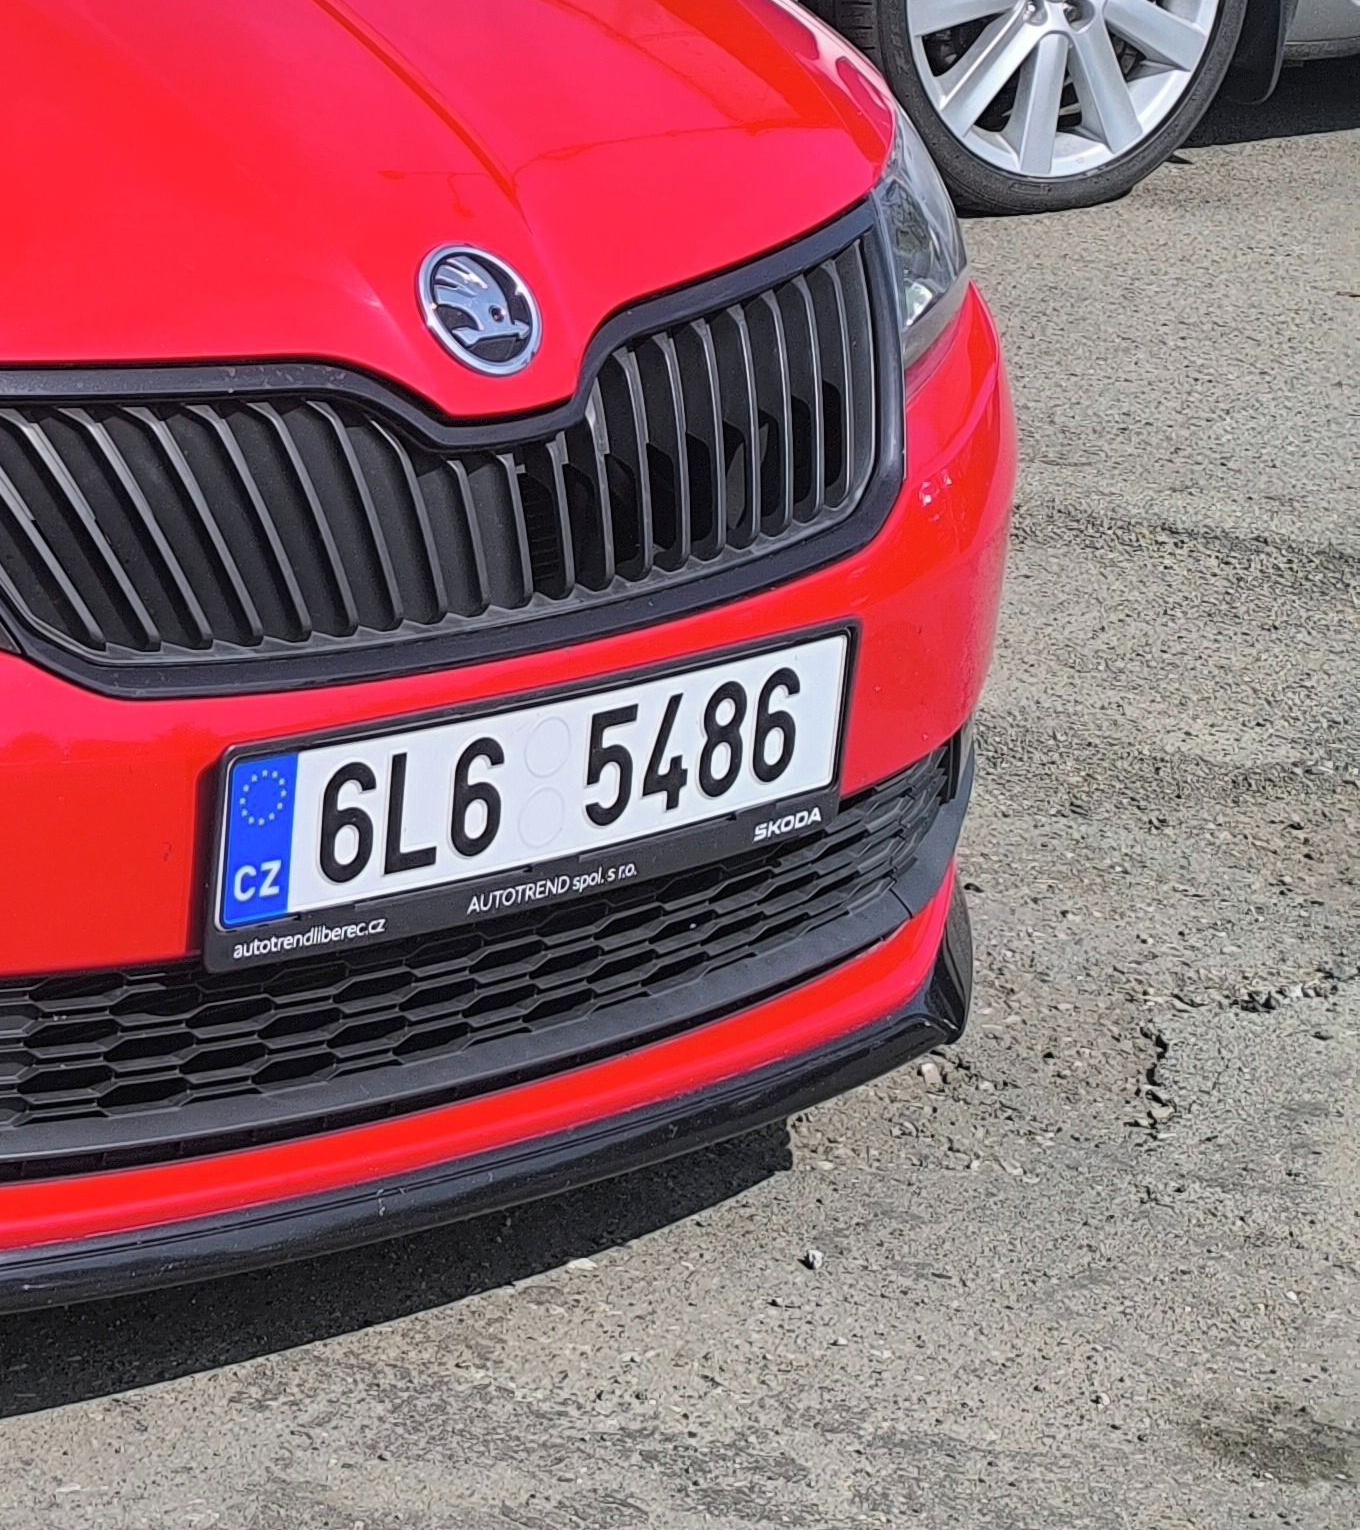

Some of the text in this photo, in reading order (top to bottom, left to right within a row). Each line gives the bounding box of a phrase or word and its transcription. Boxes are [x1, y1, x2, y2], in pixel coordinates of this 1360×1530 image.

[319, 666, 801, 884] 6L6 5486
[233, 859, 282, 902] CZ
[466, 876, 570, 916] AUTOTREND
[572, 866, 605, 893] spol.
[232, 918, 386, 959] autotrendliberec.cz
